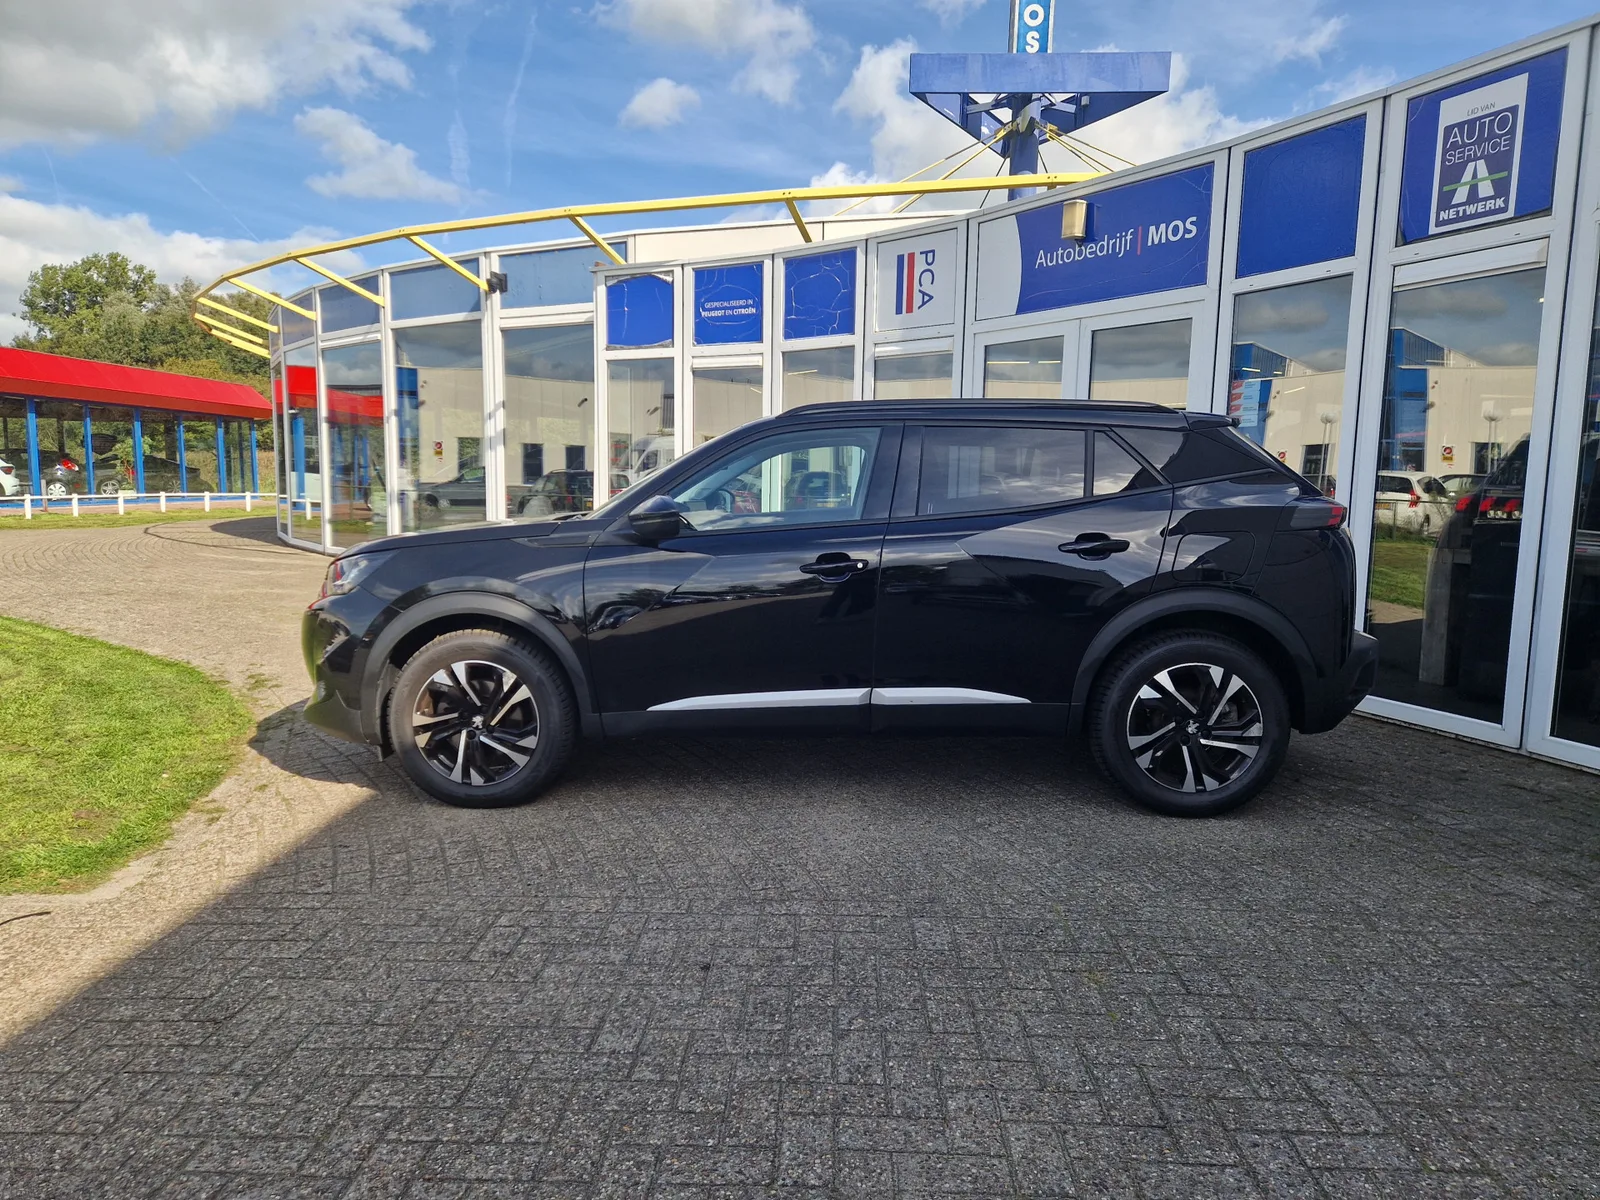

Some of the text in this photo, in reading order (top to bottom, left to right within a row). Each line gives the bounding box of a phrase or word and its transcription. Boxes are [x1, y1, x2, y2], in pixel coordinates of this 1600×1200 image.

[1467, 102, 1496, 116] LID VAN
[1446, 111, 1513, 149] AUTO
[1445, 135, 1511, 166] SERVICE
[1439, 196, 1506, 221] NETWERK
[1035, 216, 1198, 269] Autobedrijf MOS
[917, 249, 936, 310] PCA
[702, 309, 725, 317] PEUGEOT
[704, 299, 747, 309] GESPECIALISEERD
